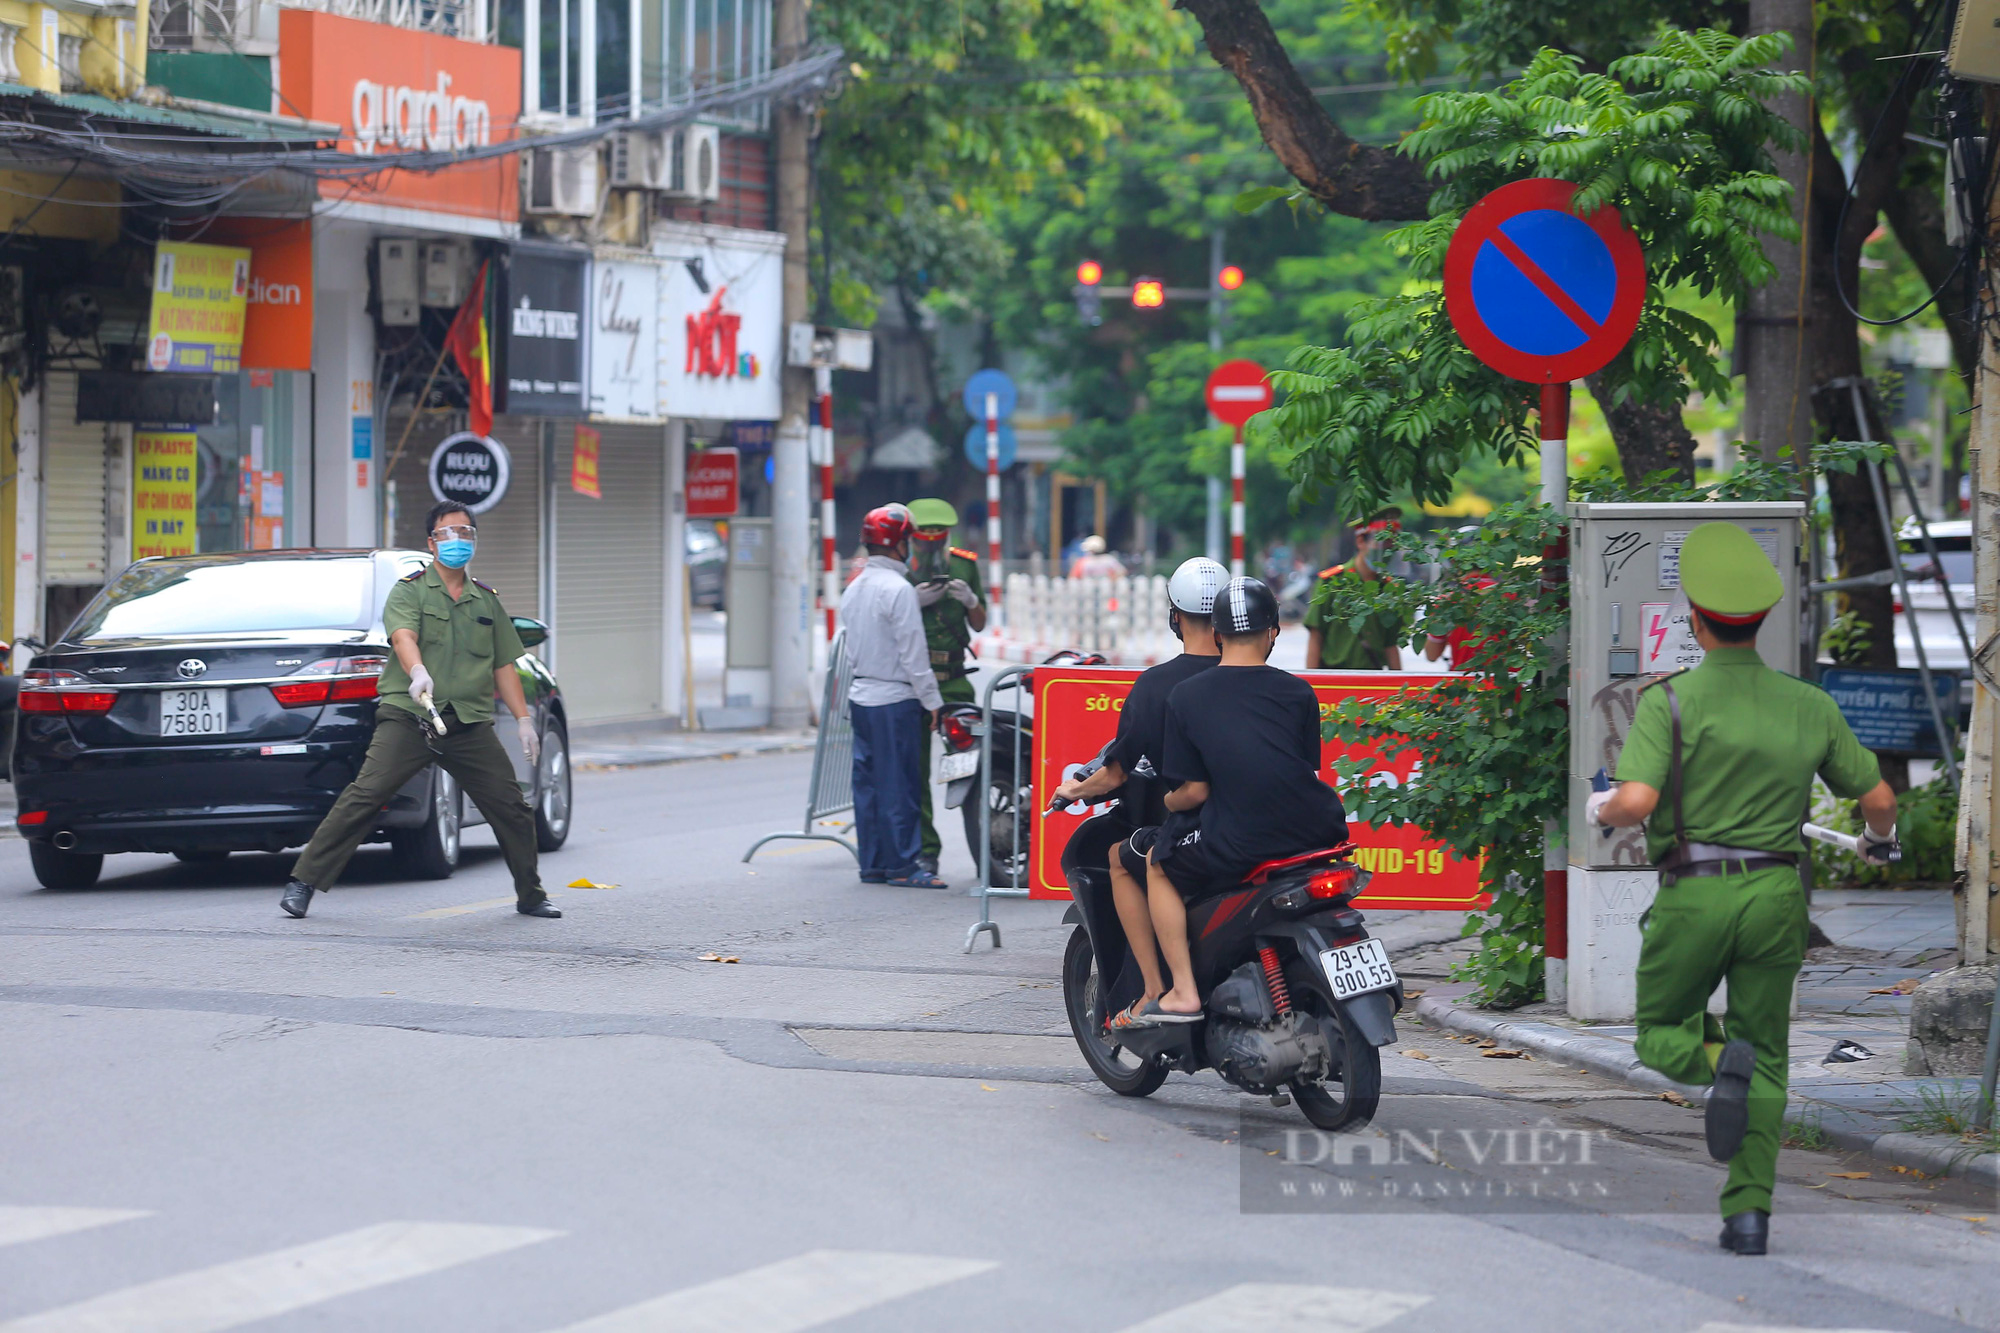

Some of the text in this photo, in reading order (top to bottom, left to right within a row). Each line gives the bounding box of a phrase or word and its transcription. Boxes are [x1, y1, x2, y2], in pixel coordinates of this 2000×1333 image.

[352, 70, 490, 156] guardian
[177, 692, 211, 711] 30A
[1085, 693, 1110, 711] SỞ
[163, 712, 223, 734] 758.01
[1348, 847, 1445, 875] OVID-19
[1331, 943, 1378, 972] 29-C1
[1334, 963, 1392, 994] 900.55
